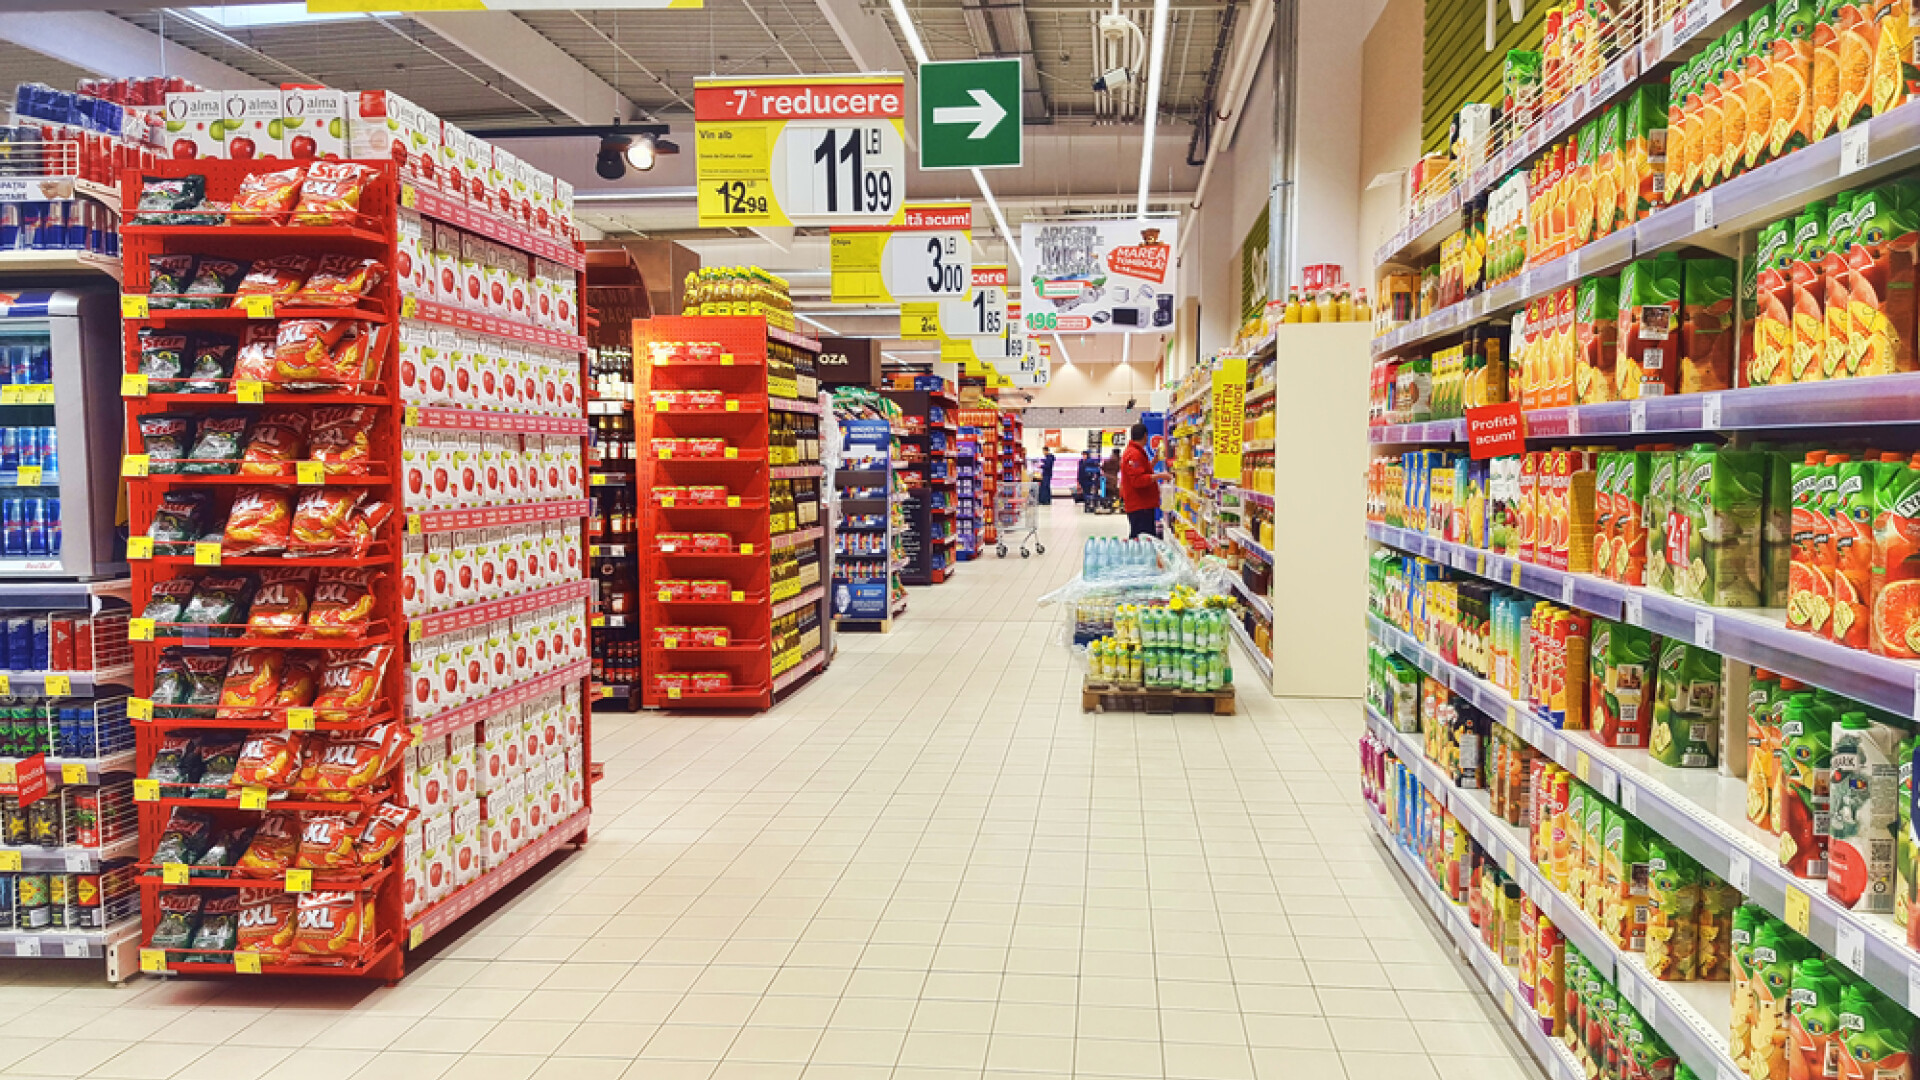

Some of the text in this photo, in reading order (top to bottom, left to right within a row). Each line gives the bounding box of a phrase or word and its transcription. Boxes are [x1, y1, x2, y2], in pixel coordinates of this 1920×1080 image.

[190, 100, 219, 111] alma
[249, 99, 278, 110] alma
[307, 97, 336, 108] alma
[762, 87, 899, 114] reducere
[699, 130, 732, 140] Vin alb
[865, 128, 882, 155] LEI
[814, 128, 863, 212] 11
[716, 181, 746, 214] 12
[865, 170, 892, 212] 99
[925, 211, 969, 226] acum!
[832, 237, 851, 247] Chips
[944, 236, 956, 255] LEI
[1117, 247, 1167, 259] MAREA
[927, 236, 944, 293] 3
[944, 264, 963, 293] 00
[973, 290, 985, 332] 1
[986, 311, 1001, 332] 85
[1026, 312, 1057, 329] 196
[1219, 383, 1234, 456] MAI IEFTIN
[1231, 383, 1245, 456] CA ORIUNDE
[1472, 413, 1518, 432] Profită
[1476, 429, 1517, 446] acum!
[323, 667, 352, 688] XXL
[18, 764, 45, 783] Profită
[22, 779, 44, 796] acum!
[239, 903, 278, 926] XXL
[299, 907, 335, 929] XXL
